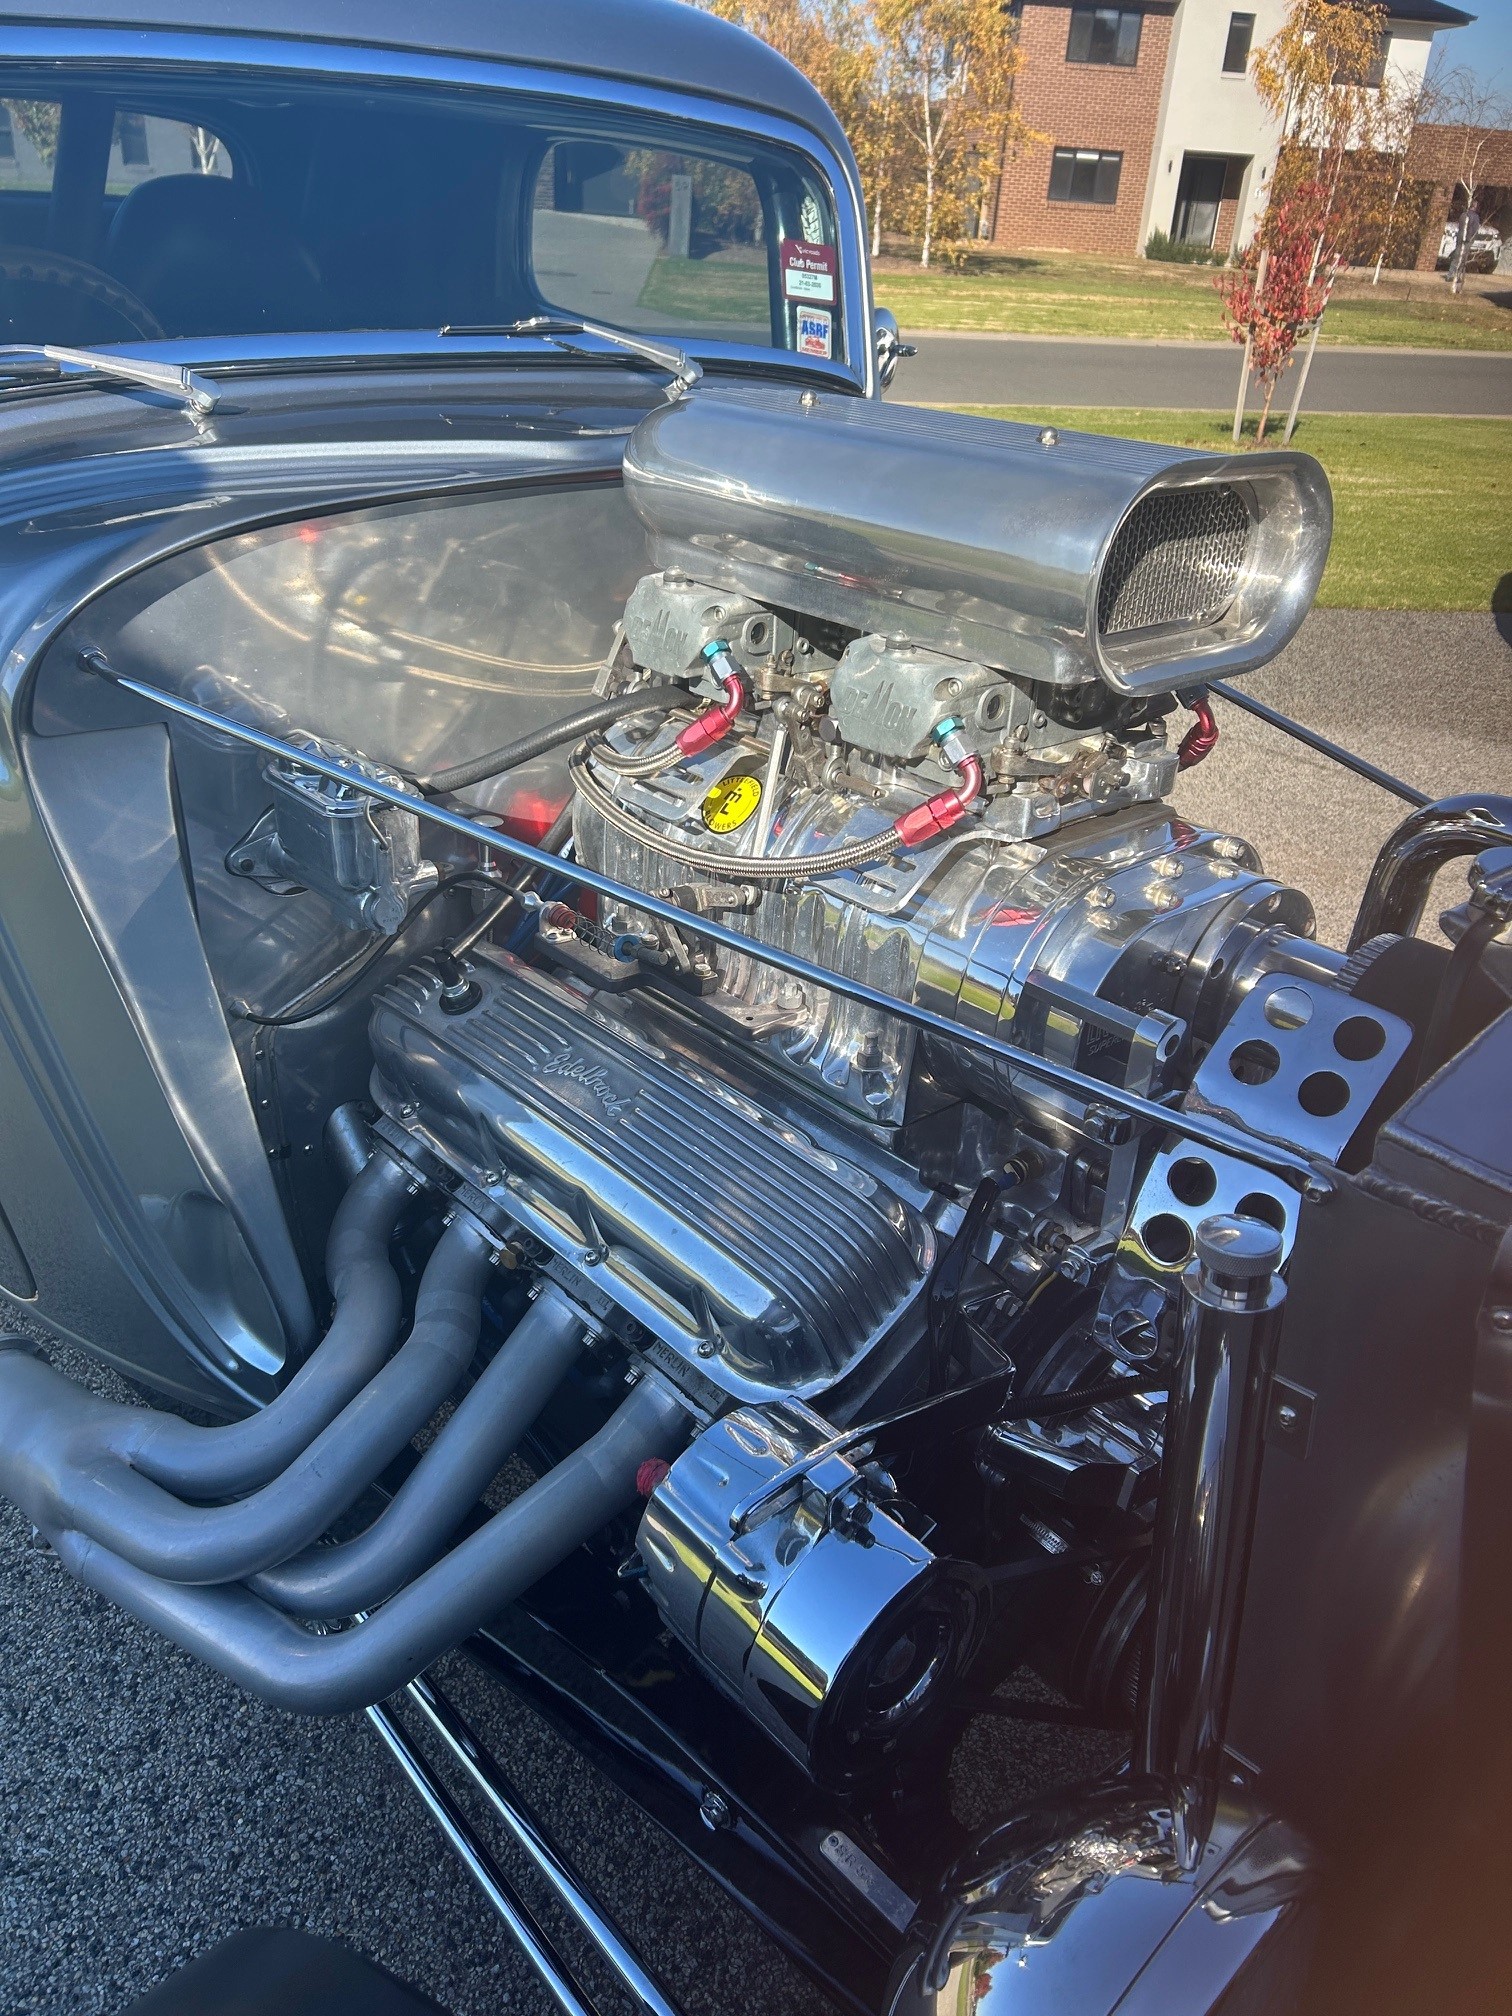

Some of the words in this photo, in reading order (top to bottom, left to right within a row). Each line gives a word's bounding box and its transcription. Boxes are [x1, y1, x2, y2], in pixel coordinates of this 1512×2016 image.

[789, 256, 805, 269] Club
[806, 258, 828, 272] Permit
[801, 319, 829, 339] ASRF
[722, 777, 760, 797] LITTLEFIELD
[705, 810, 737, 831] BLOWERS
[652, 1341, 691, 1378] MERLIN
